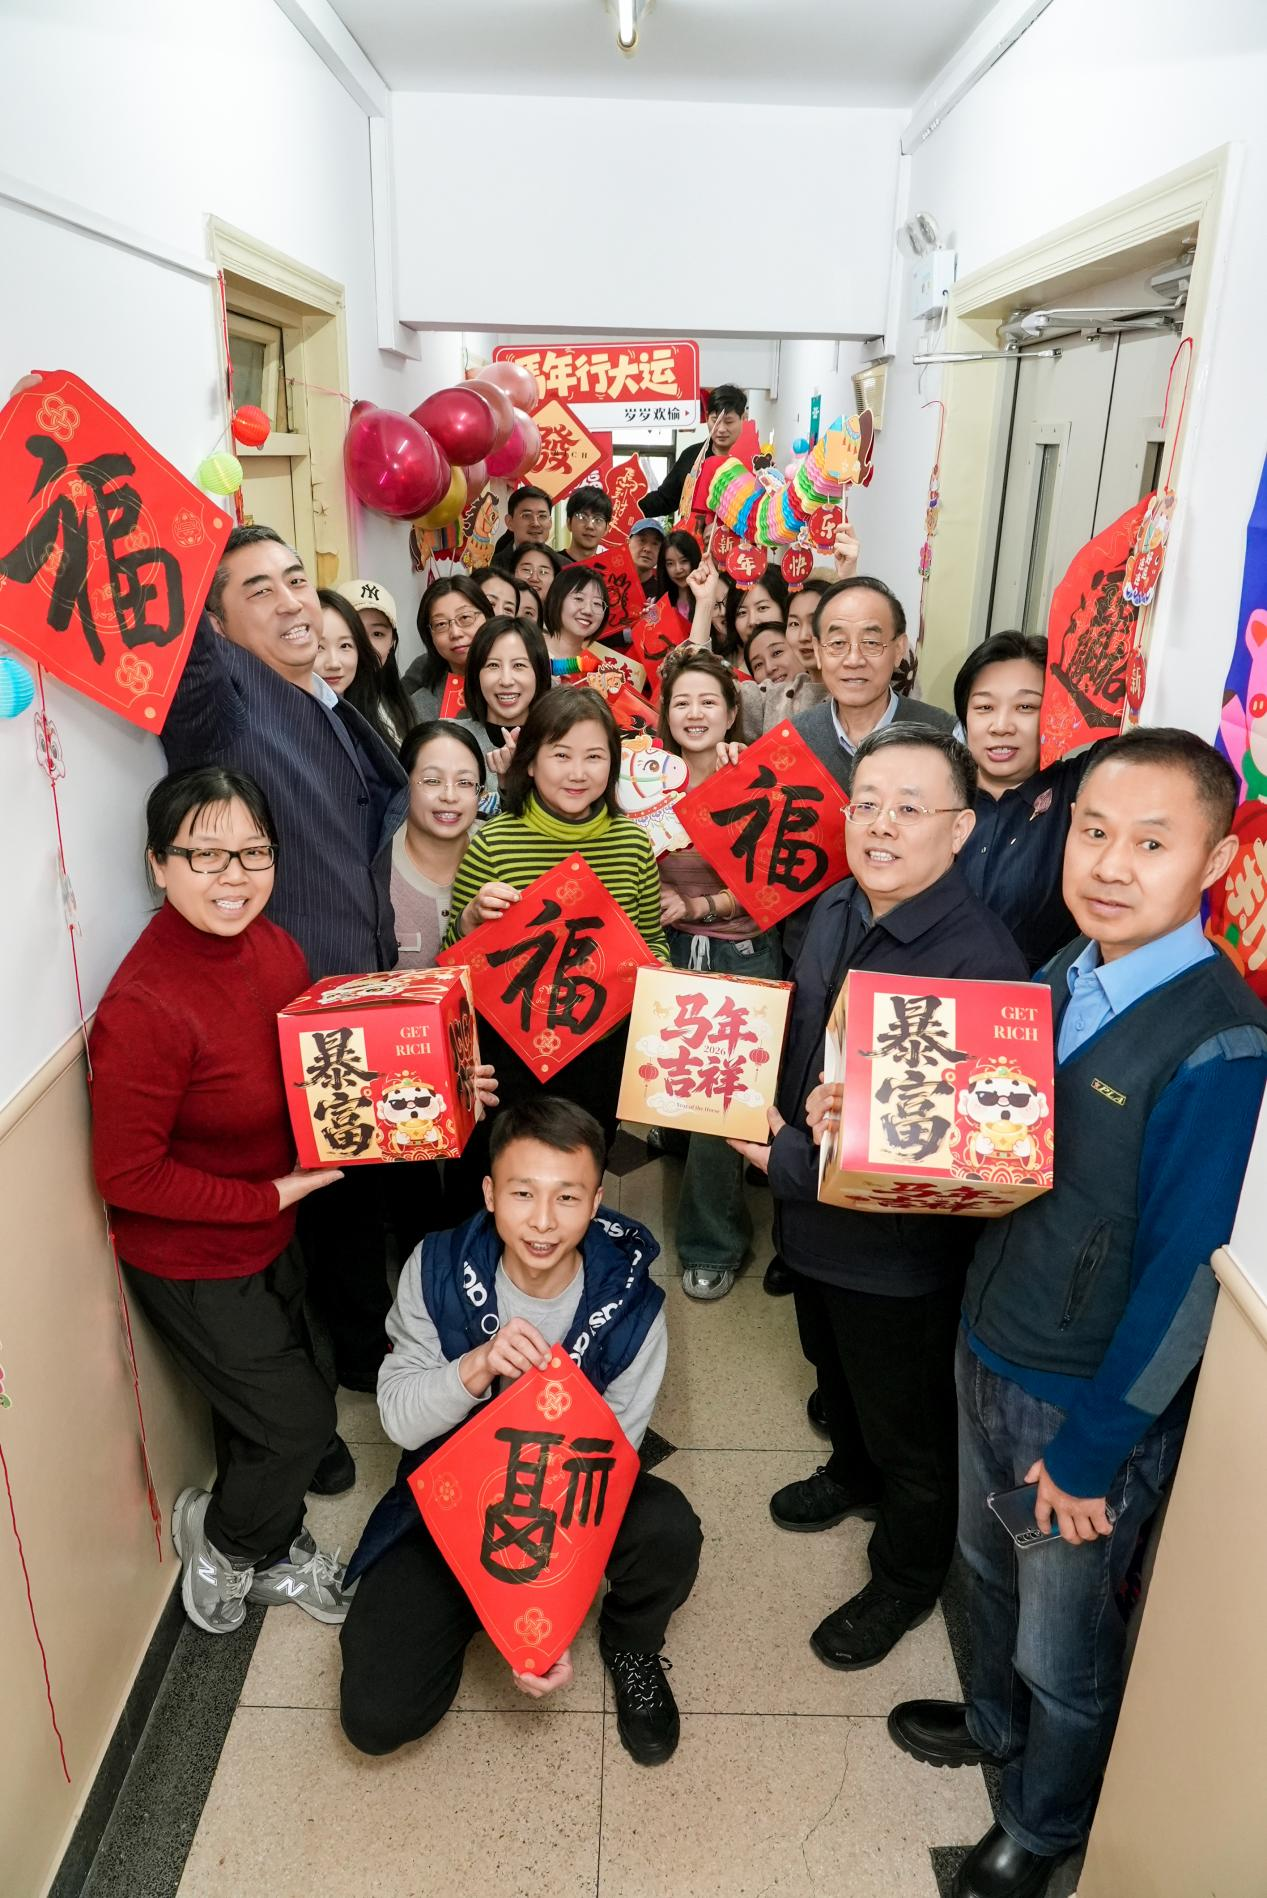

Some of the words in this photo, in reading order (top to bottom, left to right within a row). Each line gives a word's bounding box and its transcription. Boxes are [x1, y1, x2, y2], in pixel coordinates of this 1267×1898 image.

[624, 408, 681, 422] 岁岁欢愉
[531, 423, 581, 474] 發
[0, 434, 185, 666] 福
[718, 534, 735, 555] 新
[733, 554, 756, 577] 年
[788, 554, 805, 577] 快
[820, 513, 837, 539] 乐
[360, 584, 380, 601] NY
[710, 765, 829, 892] 福
[486, 899, 608, 1035] 福
[400, 1025, 430, 1038] GET
[660, 992, 758, 1057] 马年
[994, 1025, 1039, 1041] RICH
[1001, 1006, 1039, 1021] GET
[396, 1042, 431, 1056] RICH
[703, 1045, 727, 1056] 2026
[294, 1027, 385, 1158] 暴富
[657, 1045, 749, 1113] 吉祥
[858, 995, 977, 1163] 暴富
